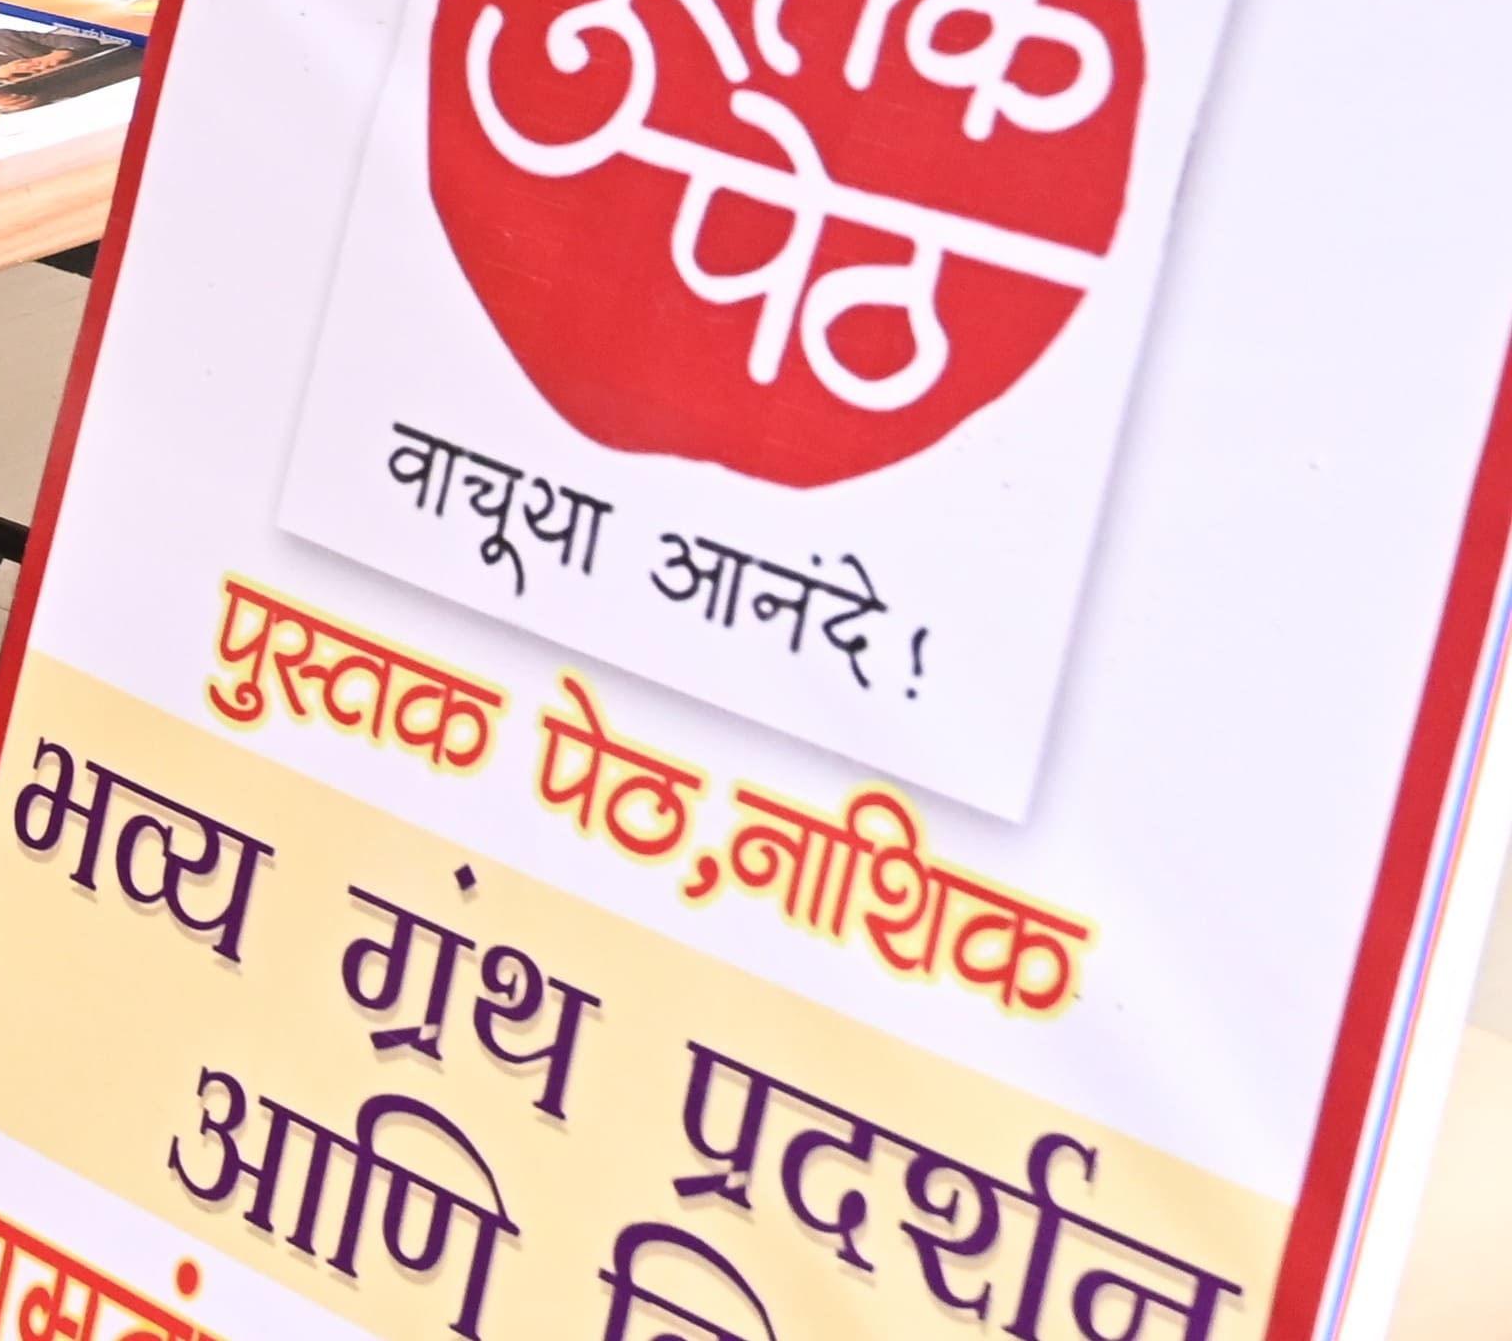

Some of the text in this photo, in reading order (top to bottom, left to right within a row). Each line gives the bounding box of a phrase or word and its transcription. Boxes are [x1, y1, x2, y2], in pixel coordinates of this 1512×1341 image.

[629, 93, 1110, 414] पेठ
[388, 420, 615, 598] वाचूया
[207, 579, 504, 767] पुस्तक
[13, 736, 276, 964] भव्य
[340, 863, 602, 1123] ग्रंथ
[672, 1039, 1244, 1341] प्रदर्शन
[166, 1066, 522, 1341] आणि
